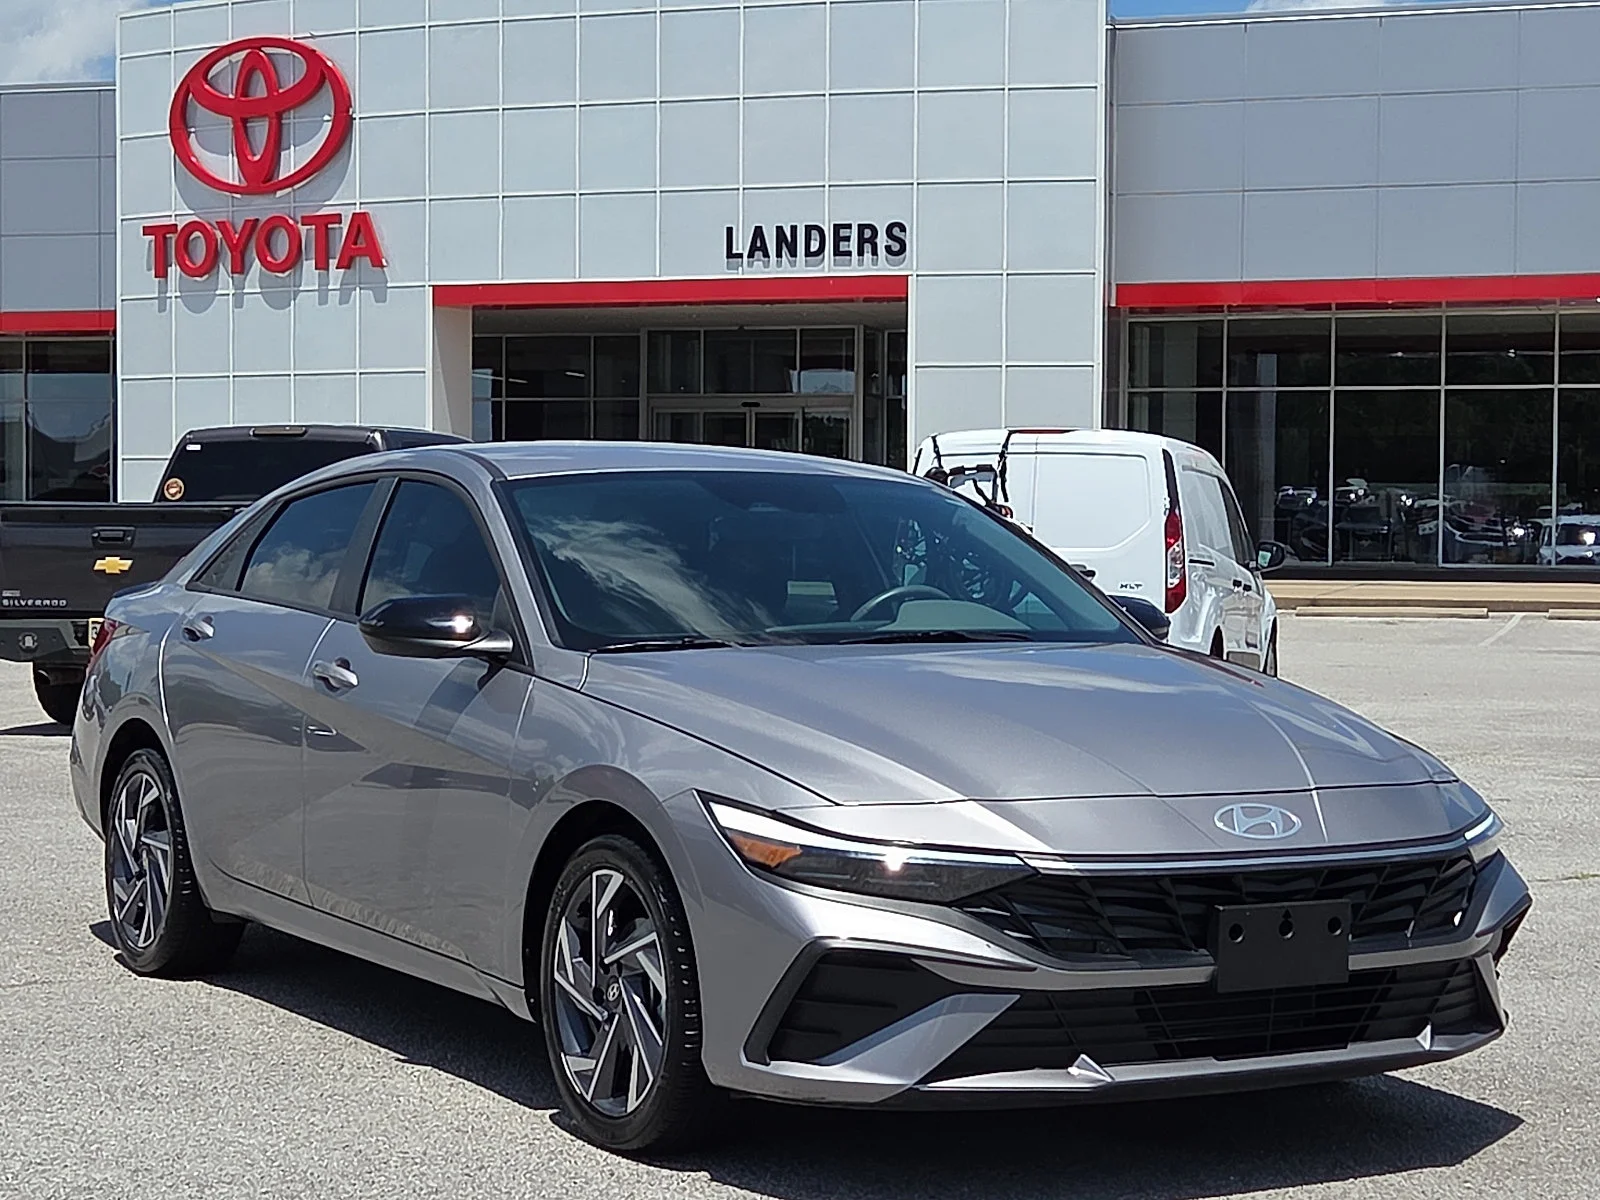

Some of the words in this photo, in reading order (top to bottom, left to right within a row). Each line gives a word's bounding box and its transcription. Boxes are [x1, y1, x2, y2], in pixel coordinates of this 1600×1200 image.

[142, 211, 388, 280] TOYOTA
[725, 221, 907, 259] LANDERS
[2, 598, 67, 607] SILVERADO
